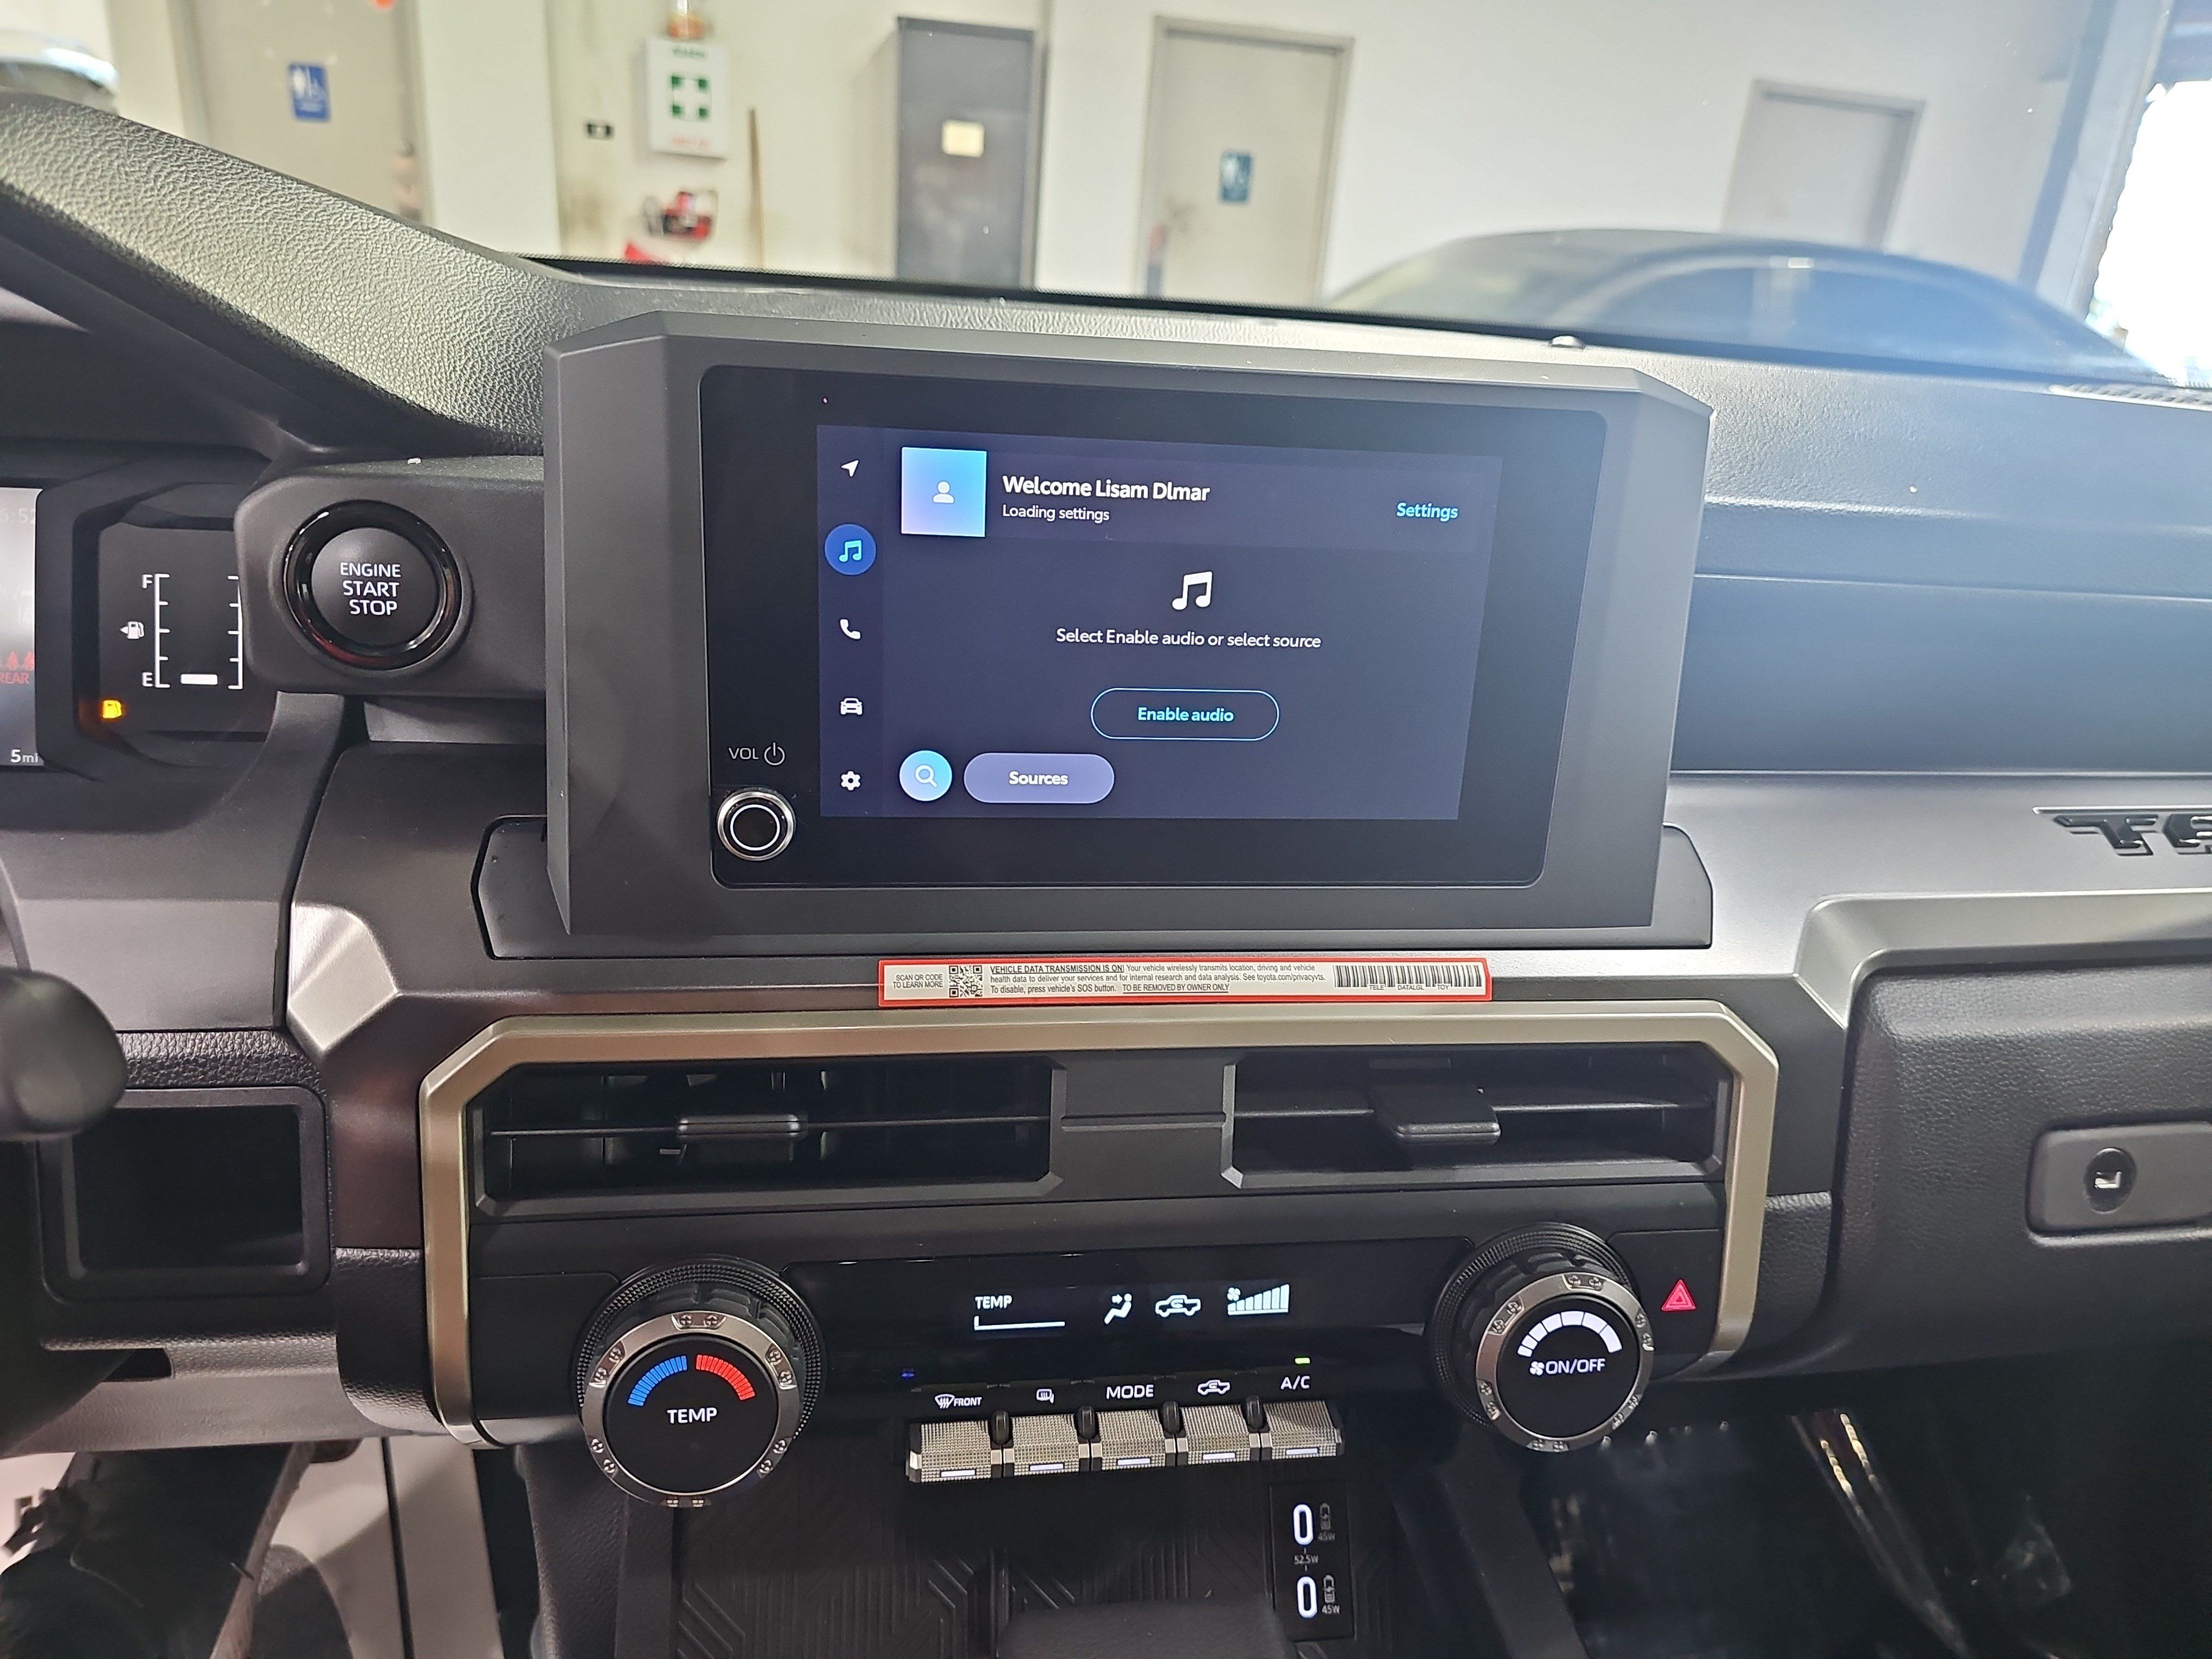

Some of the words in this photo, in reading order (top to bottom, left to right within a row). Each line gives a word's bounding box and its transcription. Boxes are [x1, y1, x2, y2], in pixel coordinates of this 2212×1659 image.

[1002, 475, 1092, 498] Welcome
[1095, 479, 1149, 499] Lisam
[1002, 504, 1056, 522] Loading
[1058, 507, 1110, 524] settings
[1396, 502, 1458, 522] Settings
[340, 562, 401, 577] ENGINE
[142, 574, 153, 589] F
[343, 580, 400, 597] START
[349, 599, 397, 615] STOP
[1056, 628, 1103, 644] Select
[1107, 629, 1159, 645] Enable
[1161, 631, 1205, 646] audio
[1207, 635, 1225, 646] or
[1227, 632, 1270, 647] select
[1272, 635, 1322, 648] source
[0, 672, 30, 684] REAR
[142, 672, 153, 687] E
[1137, 707, 1189, 721] Enable
[1191, 708, 1234, 722] audio
[728, 747, 760, 760] VOL
[1009, 770, 1069, 785] Sources
[990, 966, 1023, 974] VEHICLE
[1024, 965, 1044, 973] DATA
[1045, 964, 1101, 973] TRANSMISSION
[1167, 964, 1198, 973] wirelessly
[1257, 964, 1278, 972] driving
[1061, 976, 1075, 984] your
[1214, 973, 1242, 982] analysis.
[991, 985, 999, 993] To
[1000, 985, 1026, 994] disable,
[1027, 986, 1046, 995] press
[1047, 984, 1076, 993] vehicle's
[1077, 984, 1092, 992] SOS
[1094, 983, 1117, 992] button.
[975, 1295, 1012, 1310] TEMP
[1546, 1358, 1606, 1374] ON/OFF
[1280, 1375, 1311, 1391] A/C
[1106, 1384, 1154, 1400] MODE
[954, 1397, 982, 1406] FRONT
[667, 1407, 717, 1424] TEMP
[1321, 1605, 1340, 1615] 45W
